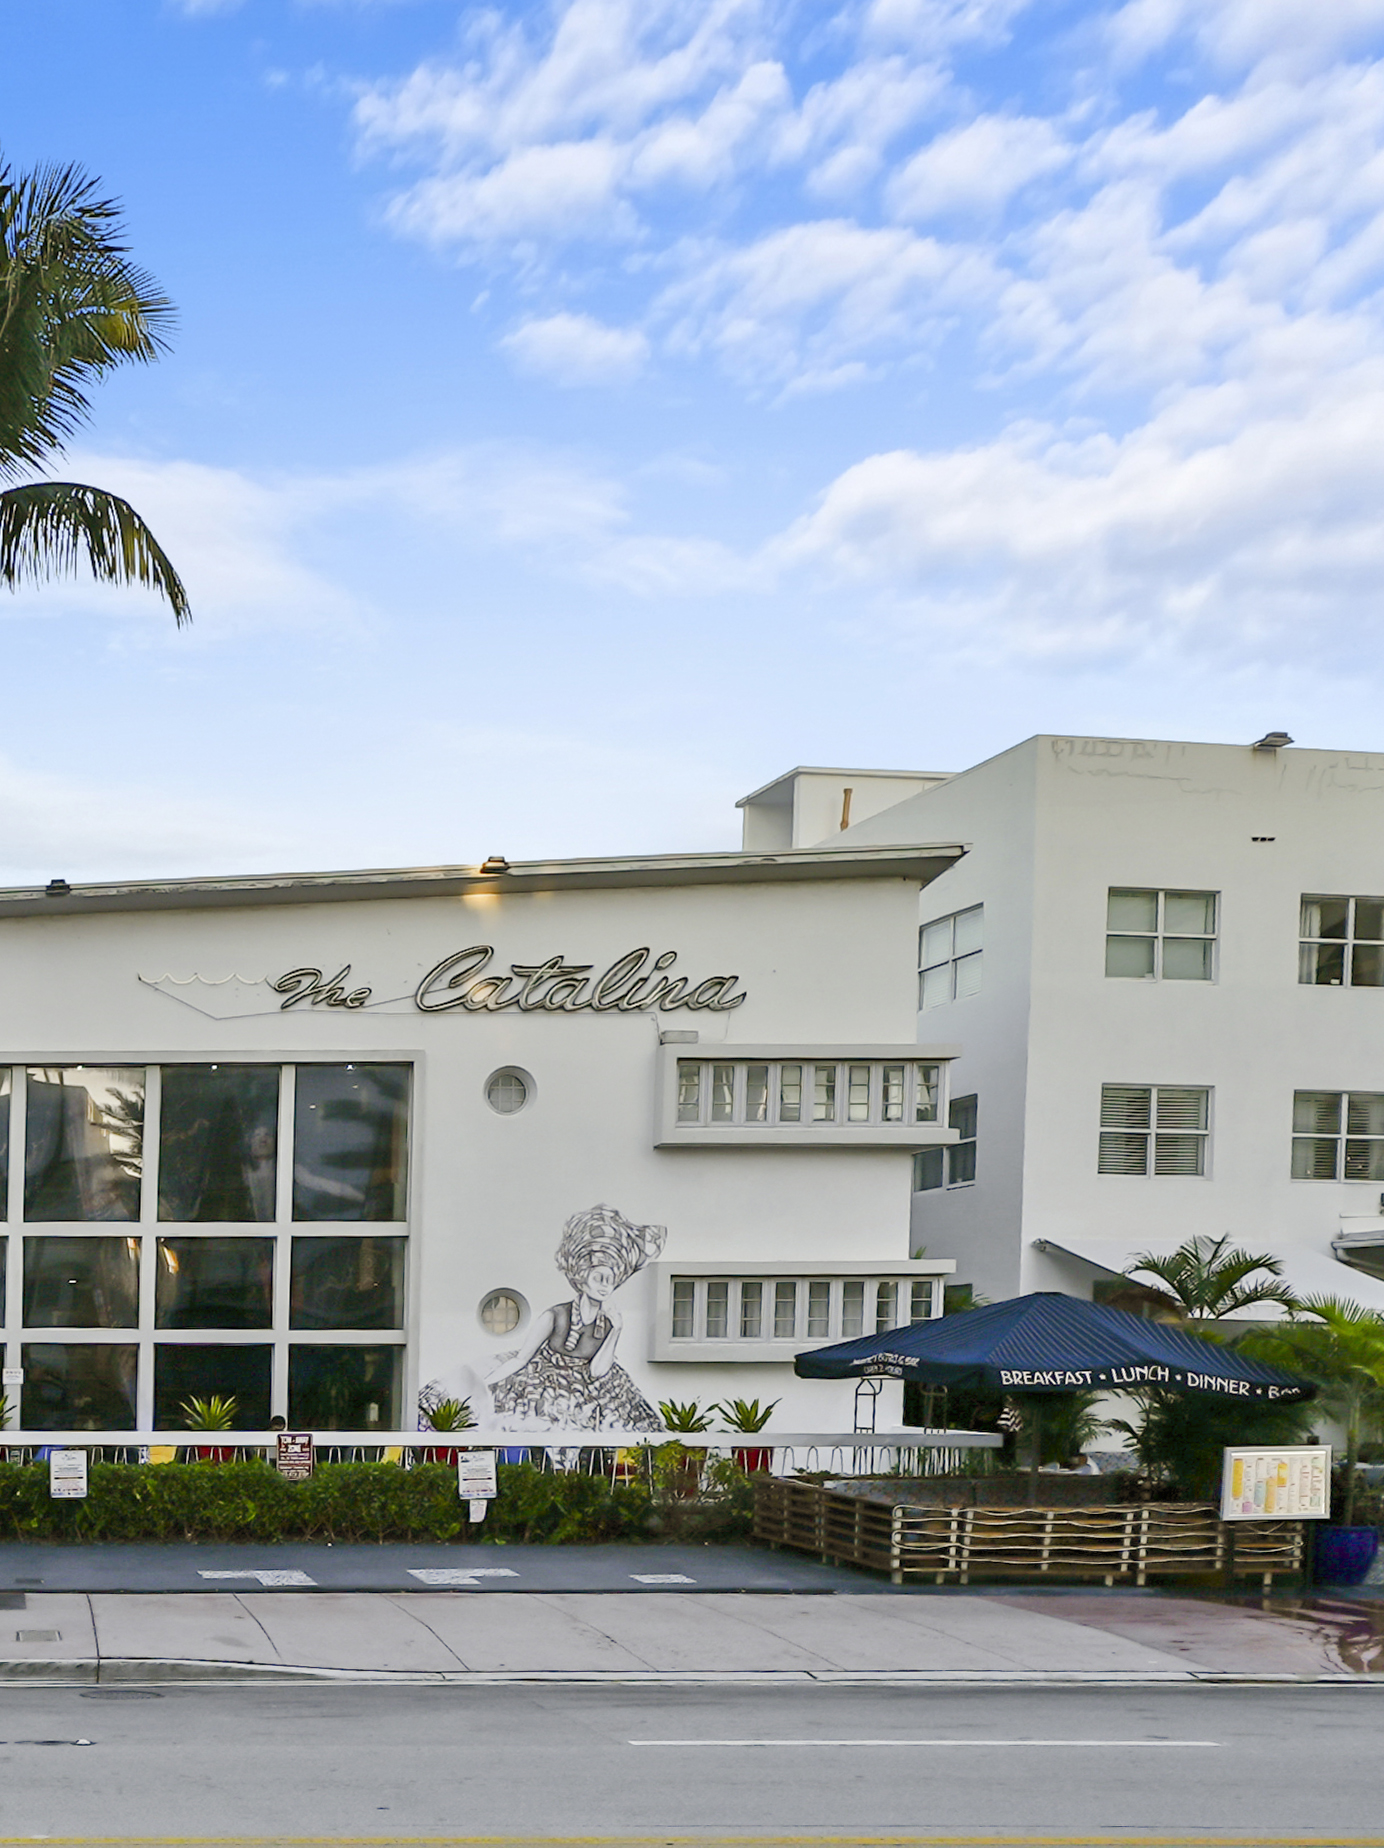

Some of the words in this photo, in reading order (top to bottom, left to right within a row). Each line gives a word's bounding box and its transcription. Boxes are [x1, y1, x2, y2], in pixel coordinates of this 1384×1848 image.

[273, 965, 373, 1009] The
[415, 945, 747, 1012] Catalina
[1000, 1370, 1093, 1386] BREAKFAST
[1111, 1366, 1170, 1384] LUNCH
[1186, 1372, 1251, 1397] DINNER
